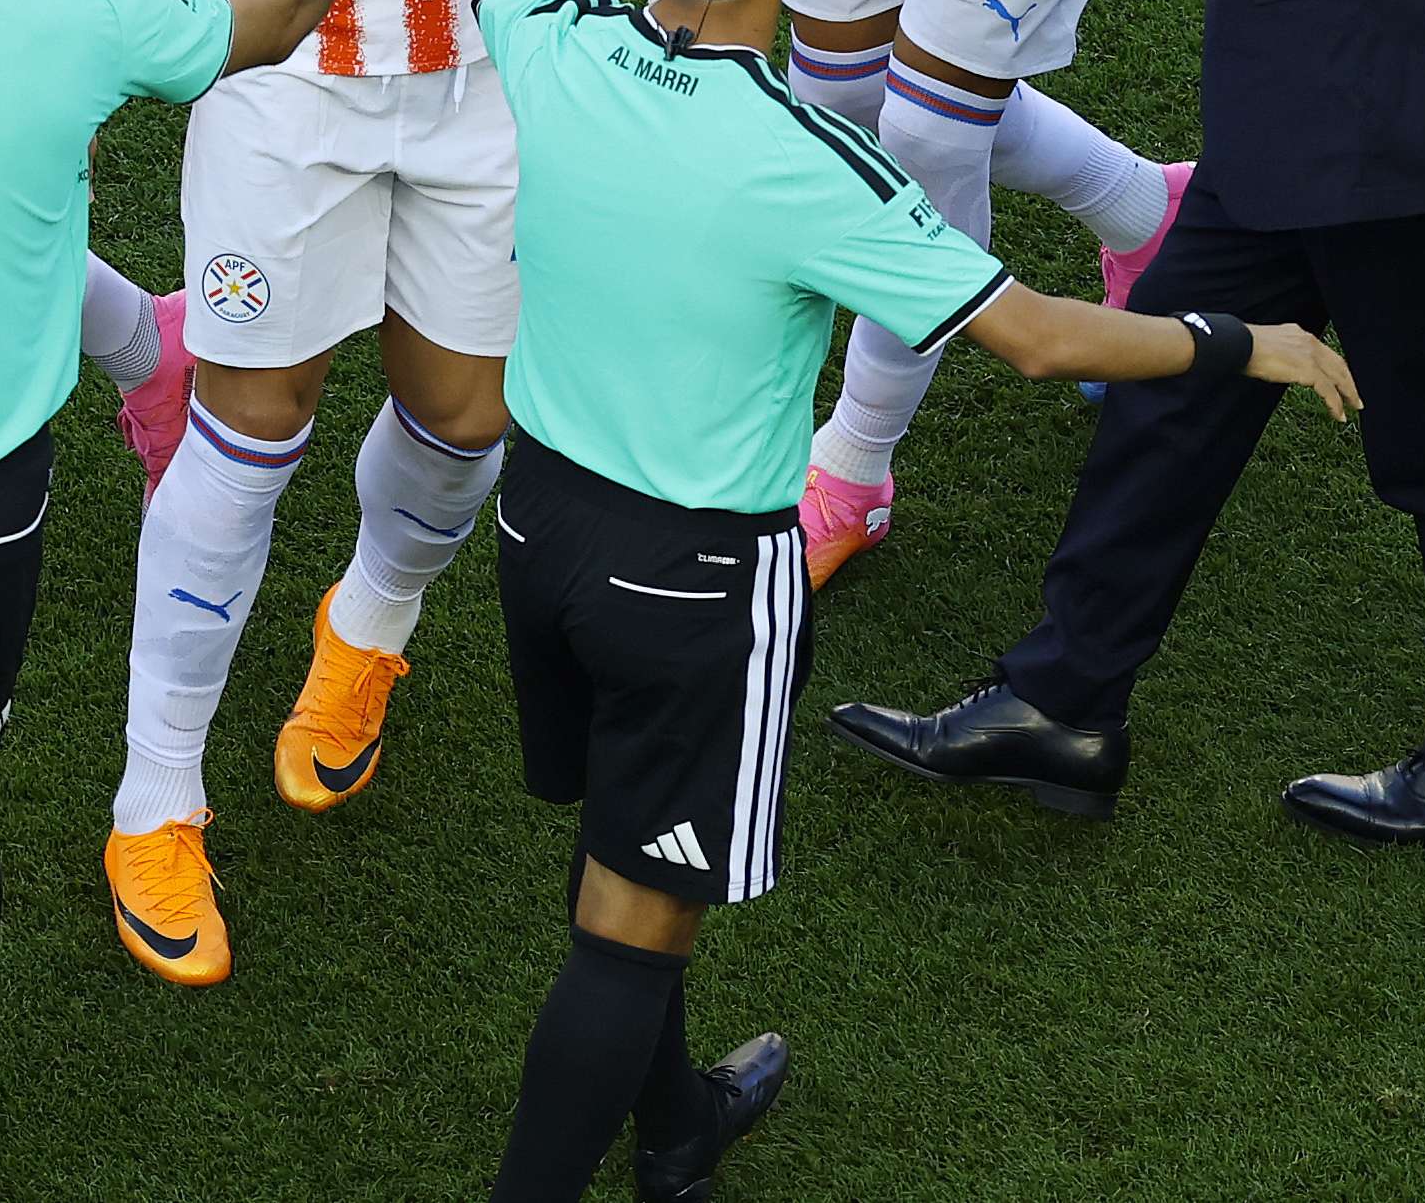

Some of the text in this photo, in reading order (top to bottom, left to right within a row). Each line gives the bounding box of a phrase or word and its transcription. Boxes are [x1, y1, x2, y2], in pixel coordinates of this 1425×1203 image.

[607, 45, 700, 97] AL MARRI
[225, 259, 246, 272] APF
